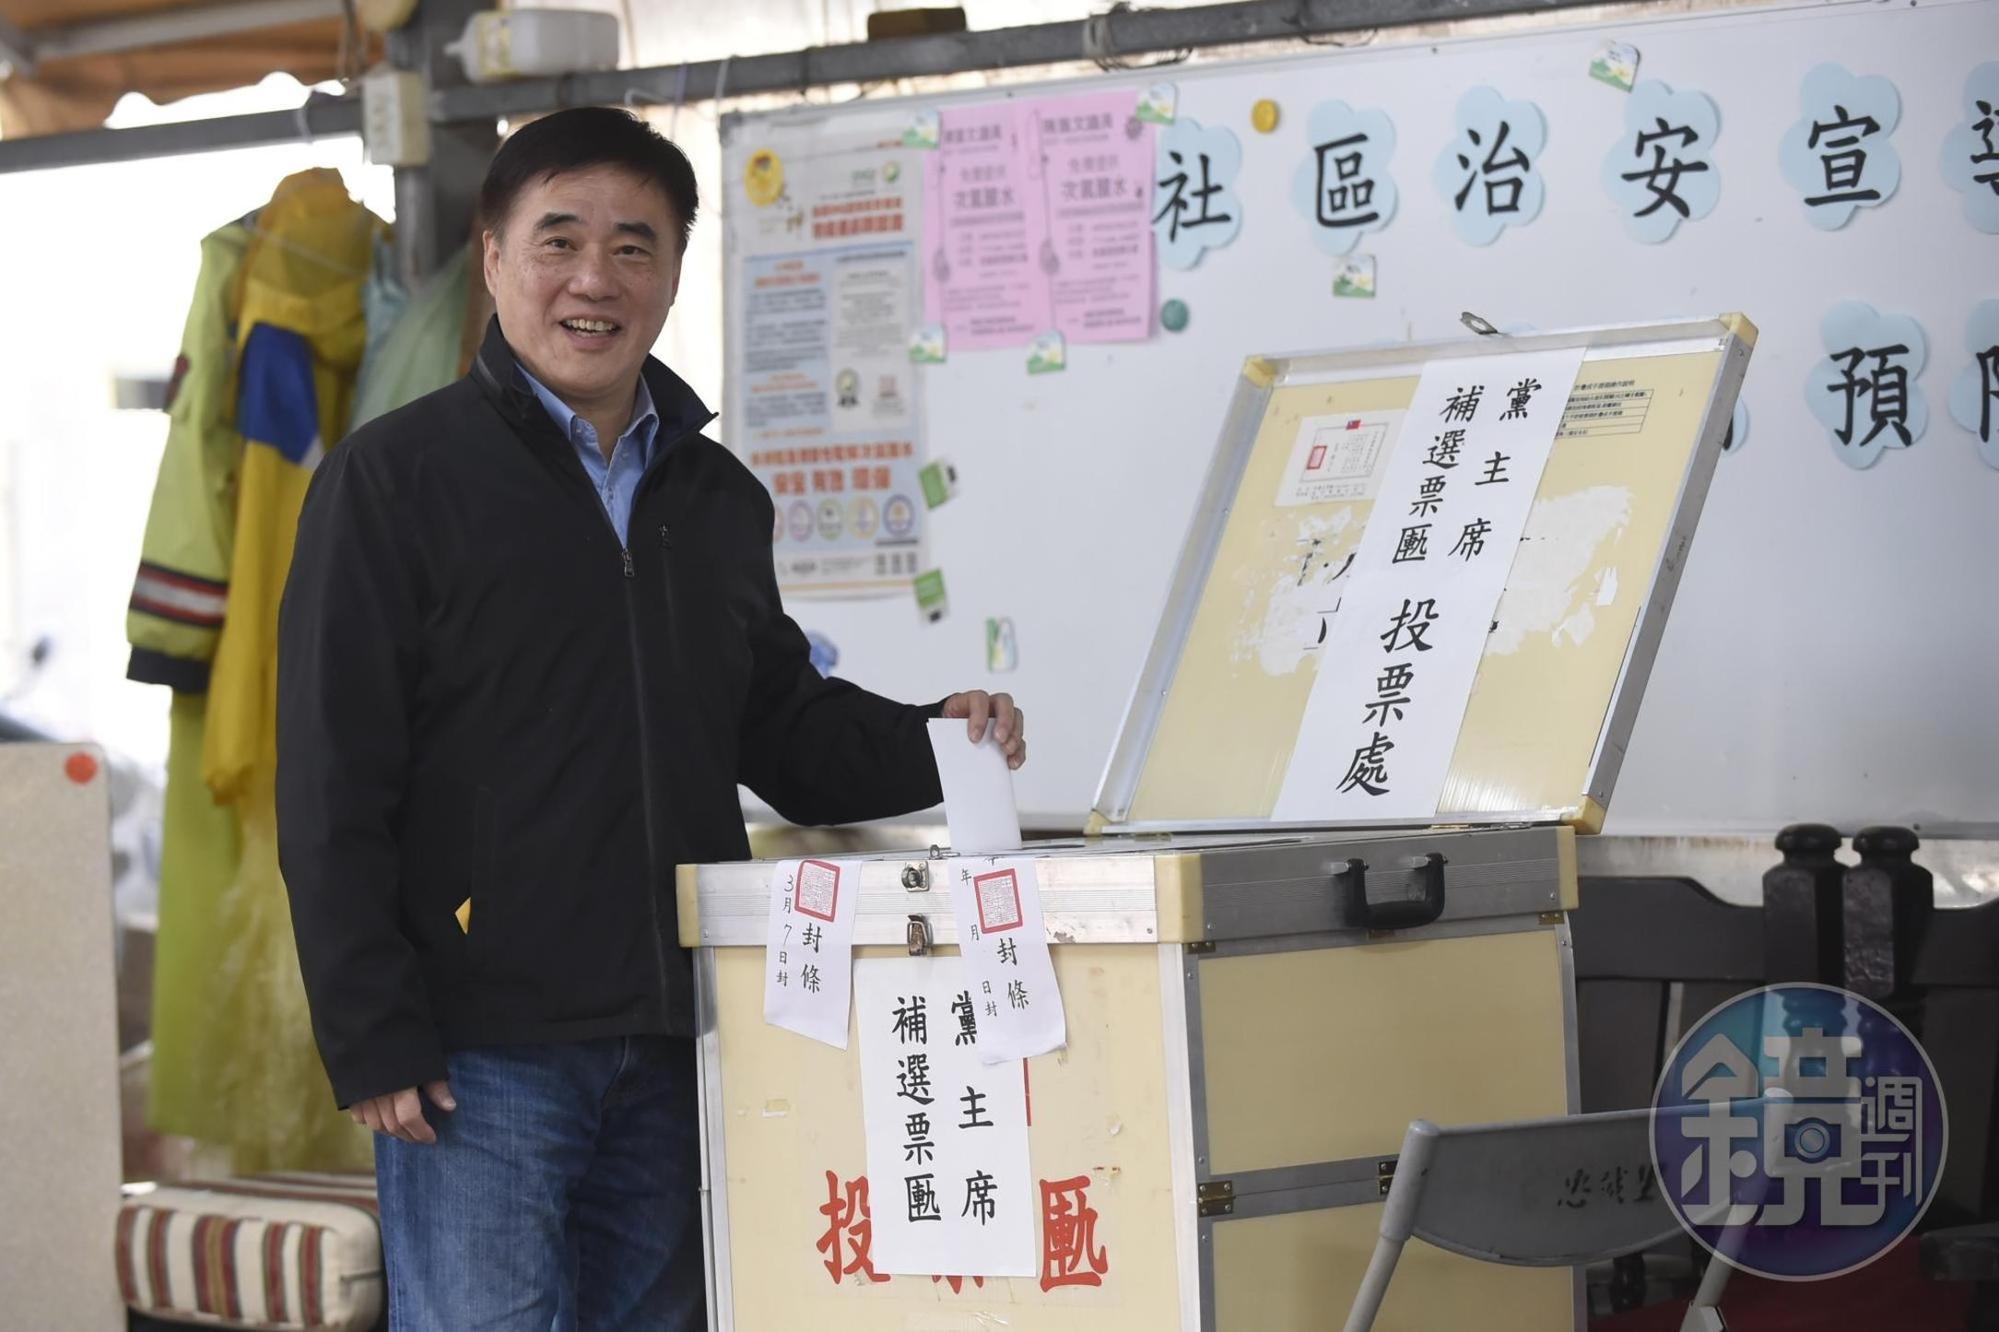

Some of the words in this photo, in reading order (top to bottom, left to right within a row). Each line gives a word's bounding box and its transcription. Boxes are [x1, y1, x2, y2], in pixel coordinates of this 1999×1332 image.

[1392, 385, 1485, 564] 補選票匭
[1448, 377, 1542, 562] 黨主席
[1336, 598, 1439, 796] 投票處
[800, 921, 823, 994] 封條
[996, 937, 1030, 1011] 封條
[892, 996, 942, 1223] 補選票匭
[951, 990, 998, 1226] 黨主席
[816, 1169, 1109, 1293] 投匭
